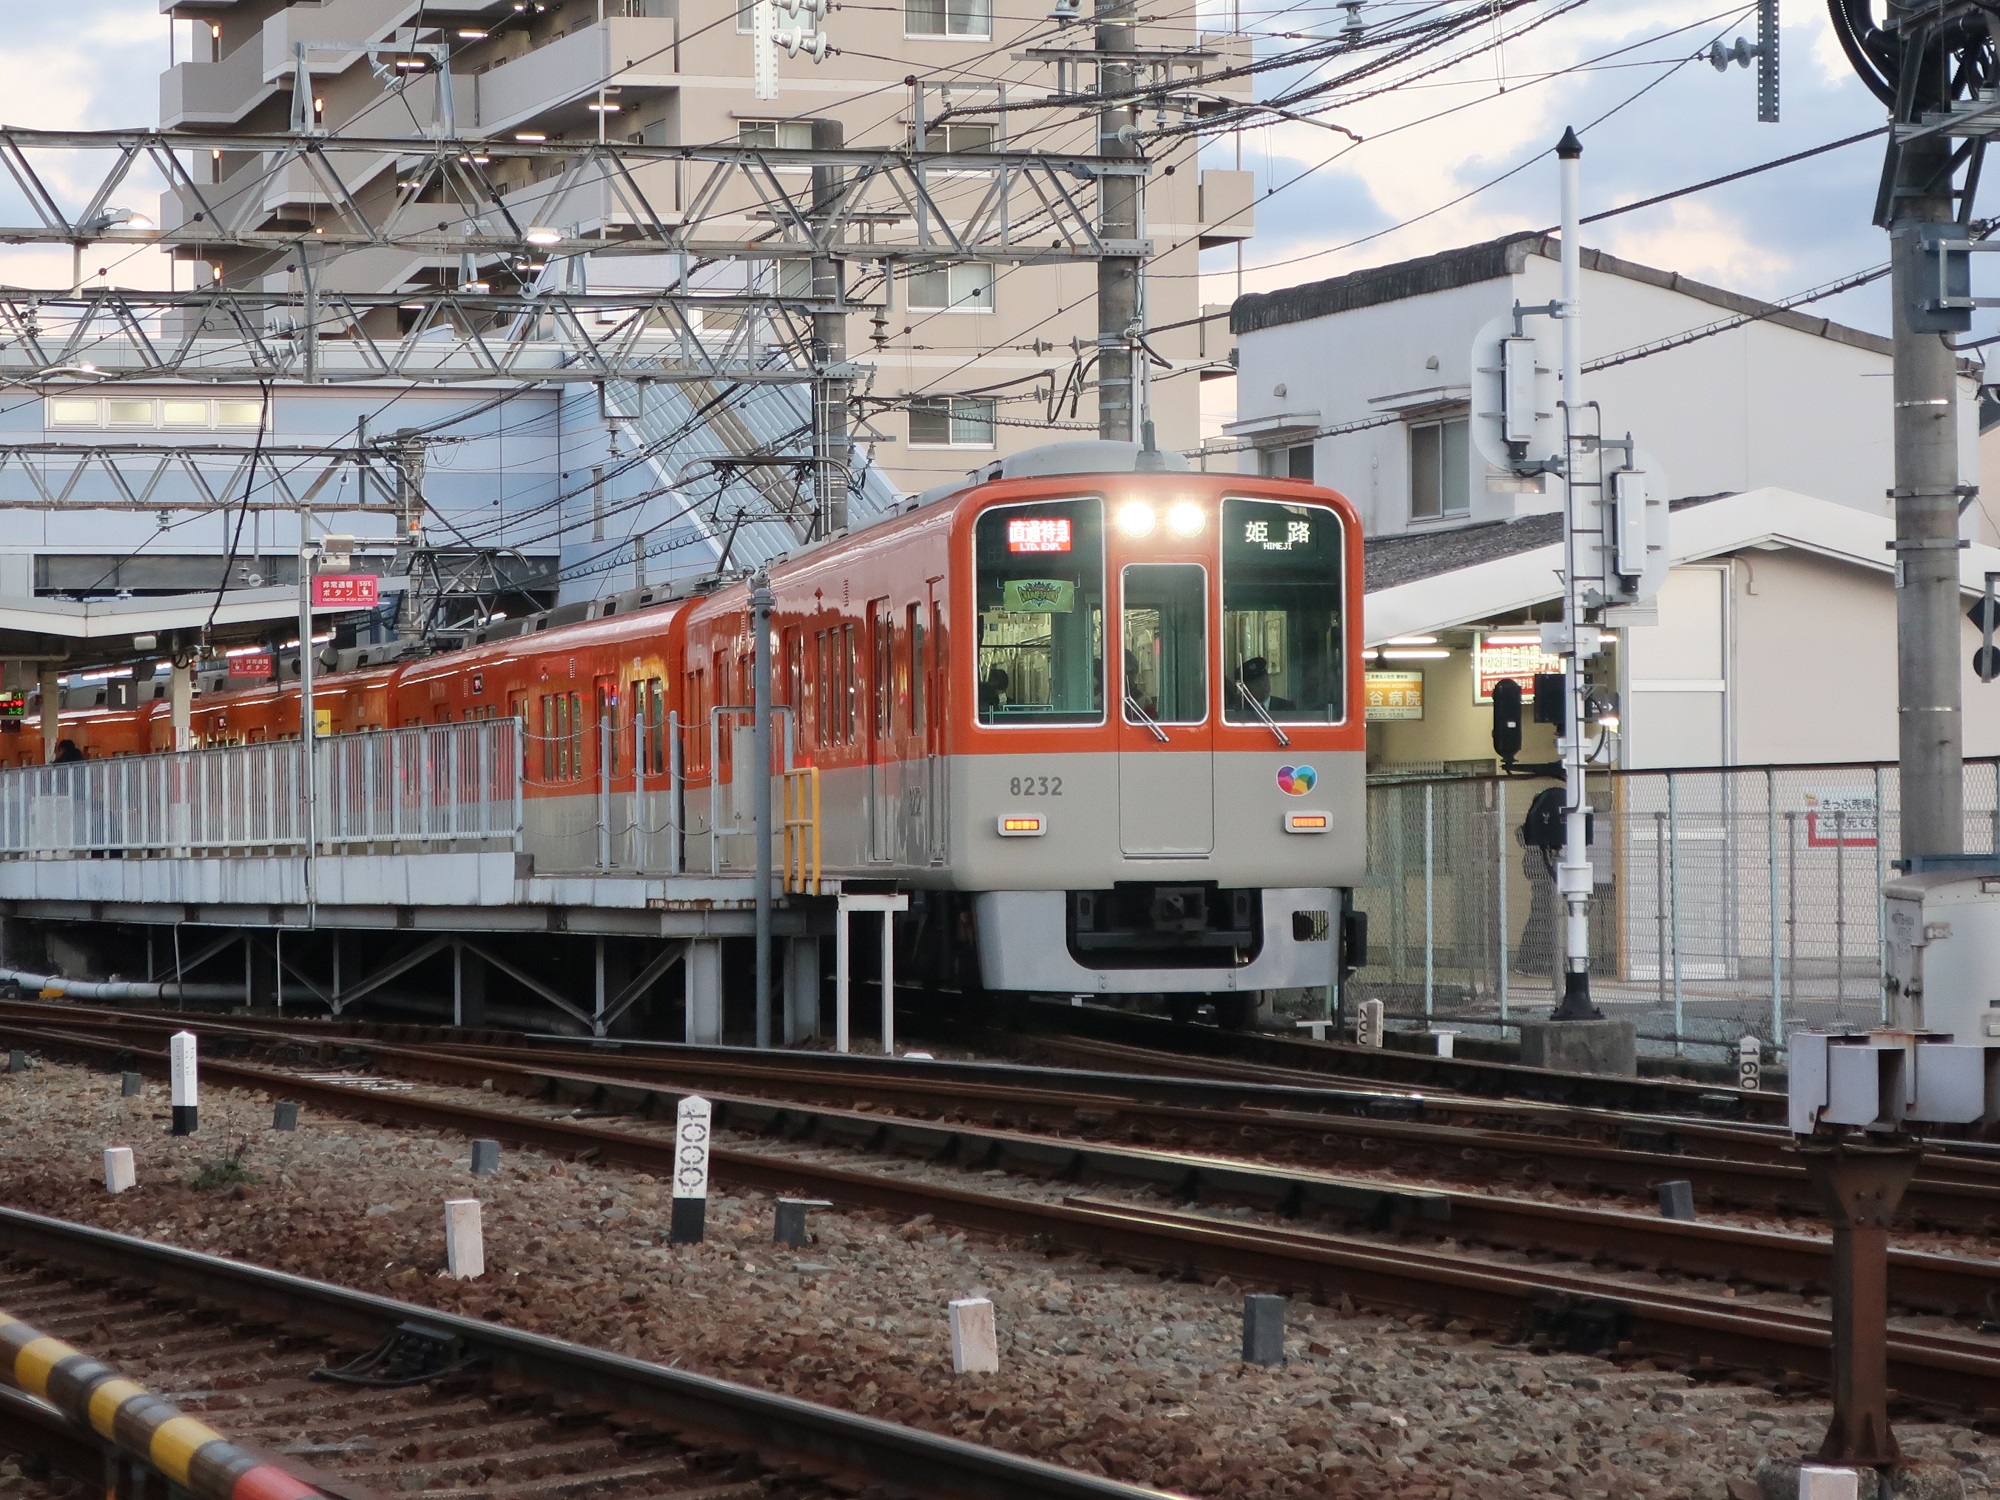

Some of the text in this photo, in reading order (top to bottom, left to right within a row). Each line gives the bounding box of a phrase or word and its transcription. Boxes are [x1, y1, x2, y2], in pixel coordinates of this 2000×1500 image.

[1009, 520, 1070, 542] 直通特急
[1245, 521, 1310, 543] 姫路
[1020, 542, 1061, 551] LTD. EXP.
[1263, 542, 1293, 551] HIMEJI
[322, 580, 353, 589] 非常通報
[323, 589, 353, 597] ボタン
[118, 684, 126, 704] 1
[1369, 690, 1421, 706] 谷病院
[1010, 776, 1063, 796] 8232
[1741, 1047, 1759, 1089] 160
